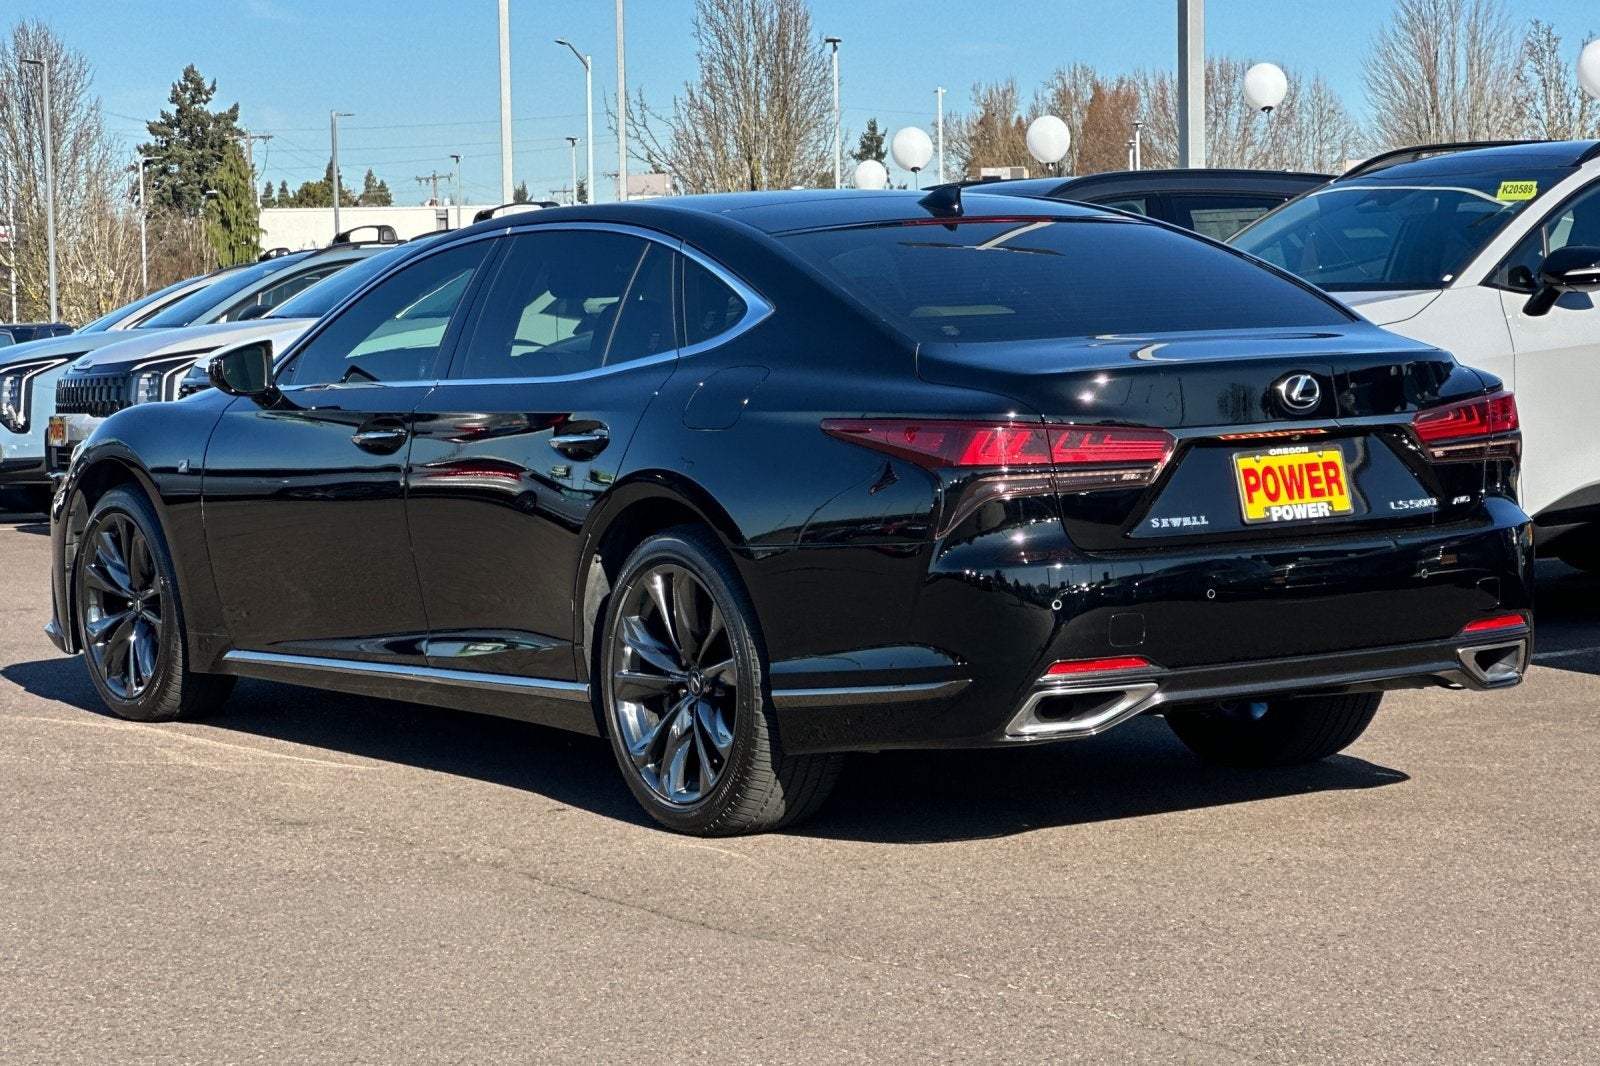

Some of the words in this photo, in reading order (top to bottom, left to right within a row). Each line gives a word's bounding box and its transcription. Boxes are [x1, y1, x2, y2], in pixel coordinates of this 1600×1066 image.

[1502, 184, 1534, 194] K20589
[1268, 446, 1309, 456] OREGON
[1241, 460, 1345, 504] POWER
[1270, 501, 1330, 521] POWER
[1150, 515, 1209, 528] SEWELL
